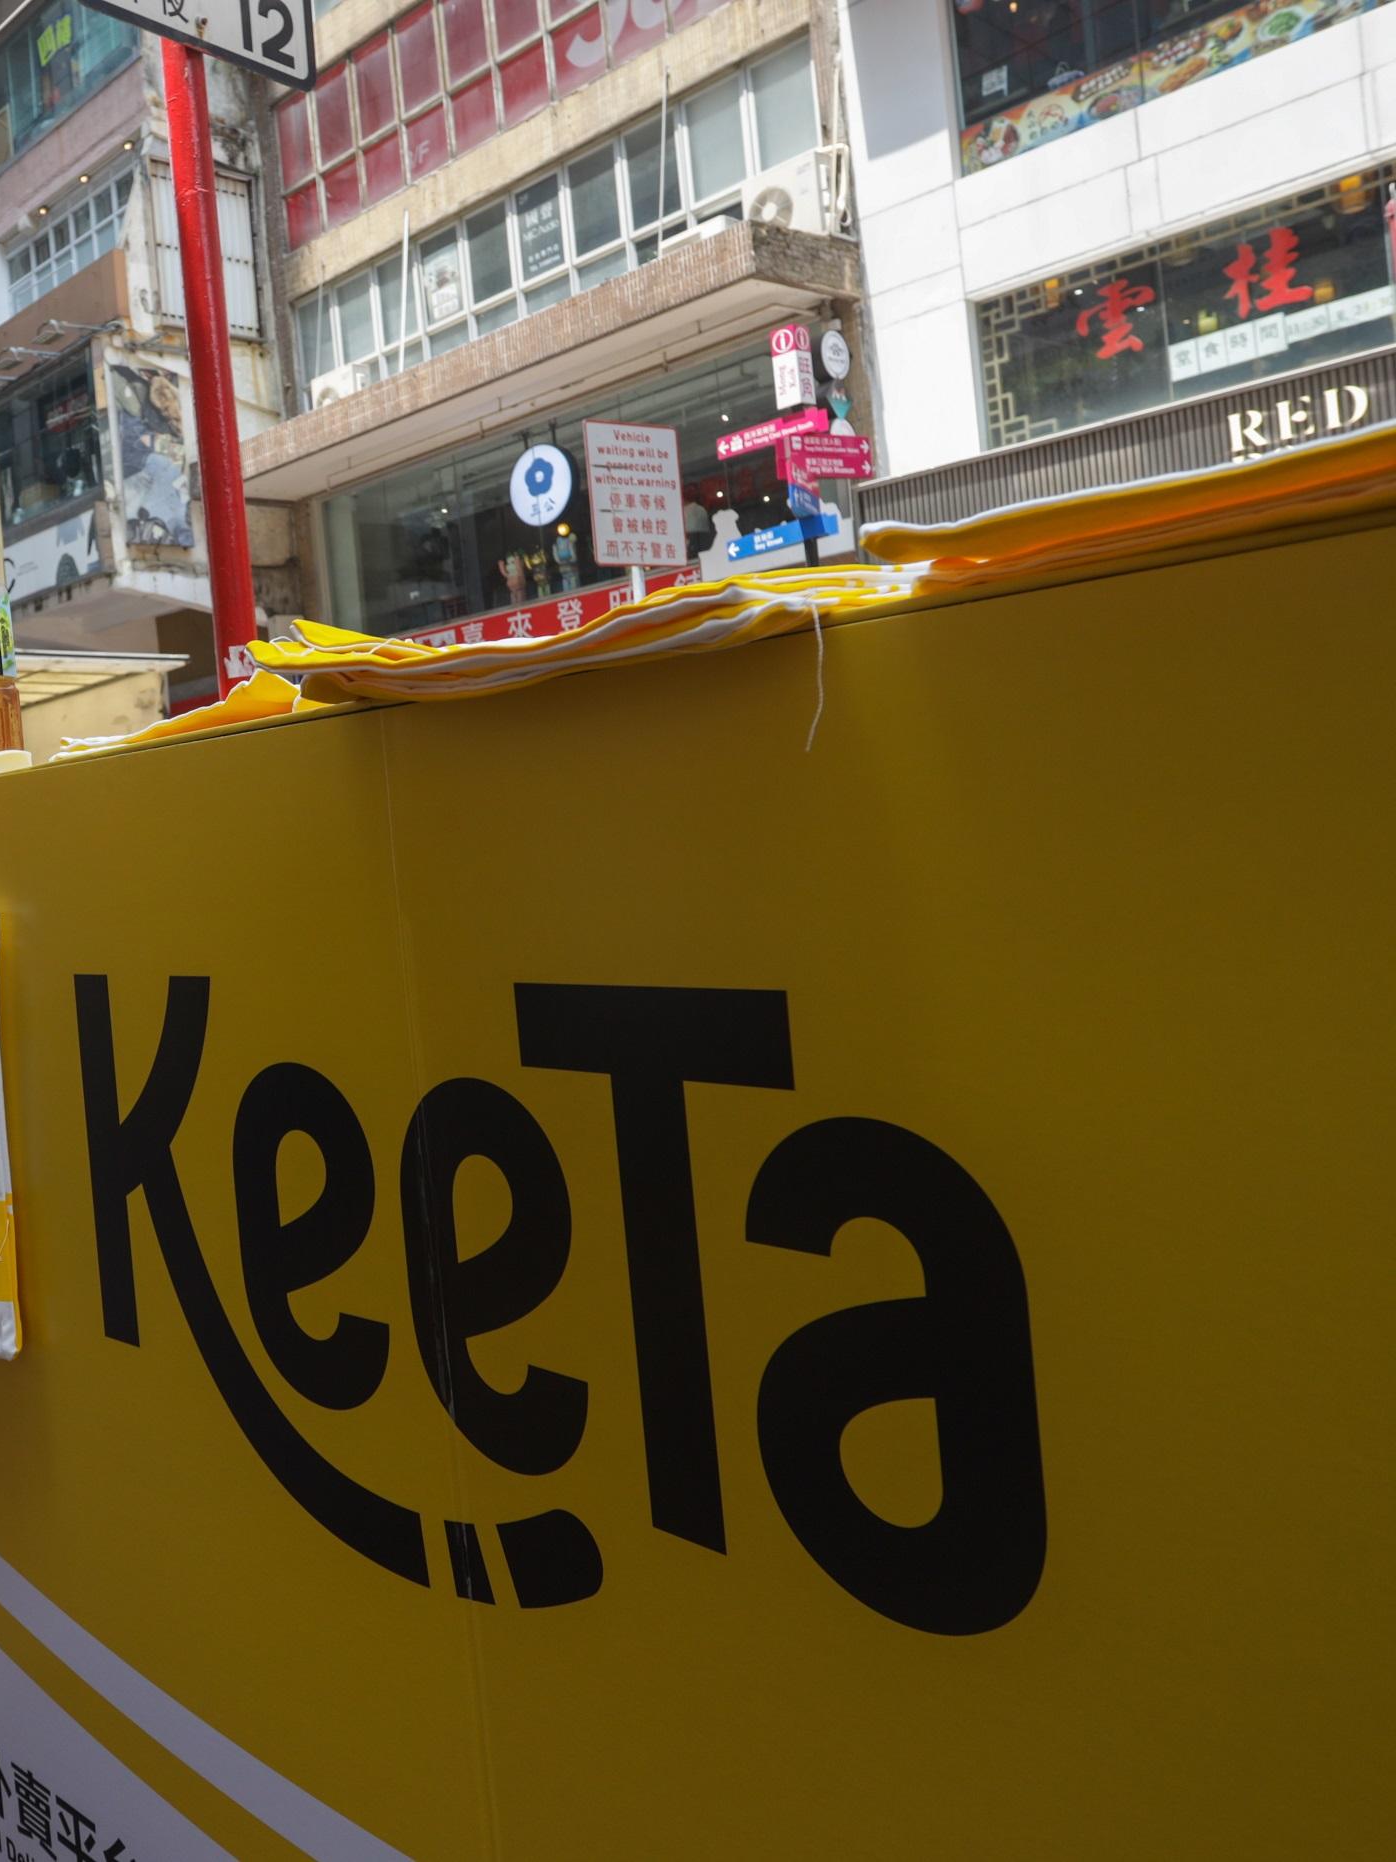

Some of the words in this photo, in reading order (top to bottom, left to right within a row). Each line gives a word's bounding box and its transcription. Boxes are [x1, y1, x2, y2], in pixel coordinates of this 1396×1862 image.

[238, 0, 297, 70] 12
[1228, 386, 1368, 453] RED
[613, 429, 651, 443] Vehicle
[597, 446, 635, 458] waiting
[638, 447, 655, 458] will
[657, 450, 669, 460] be
[606, 463, 663, 473] prosecuted
[595, 474, 634, 487] without
[636, 478, 677, 490] warning
[609, 492, 666, 511] 停車等候
[612, 516, 669, 536] 會被檢控
[605, 540, 677, 561] 而不予警告
[74, 973, 1047, 1637] KeeTa
